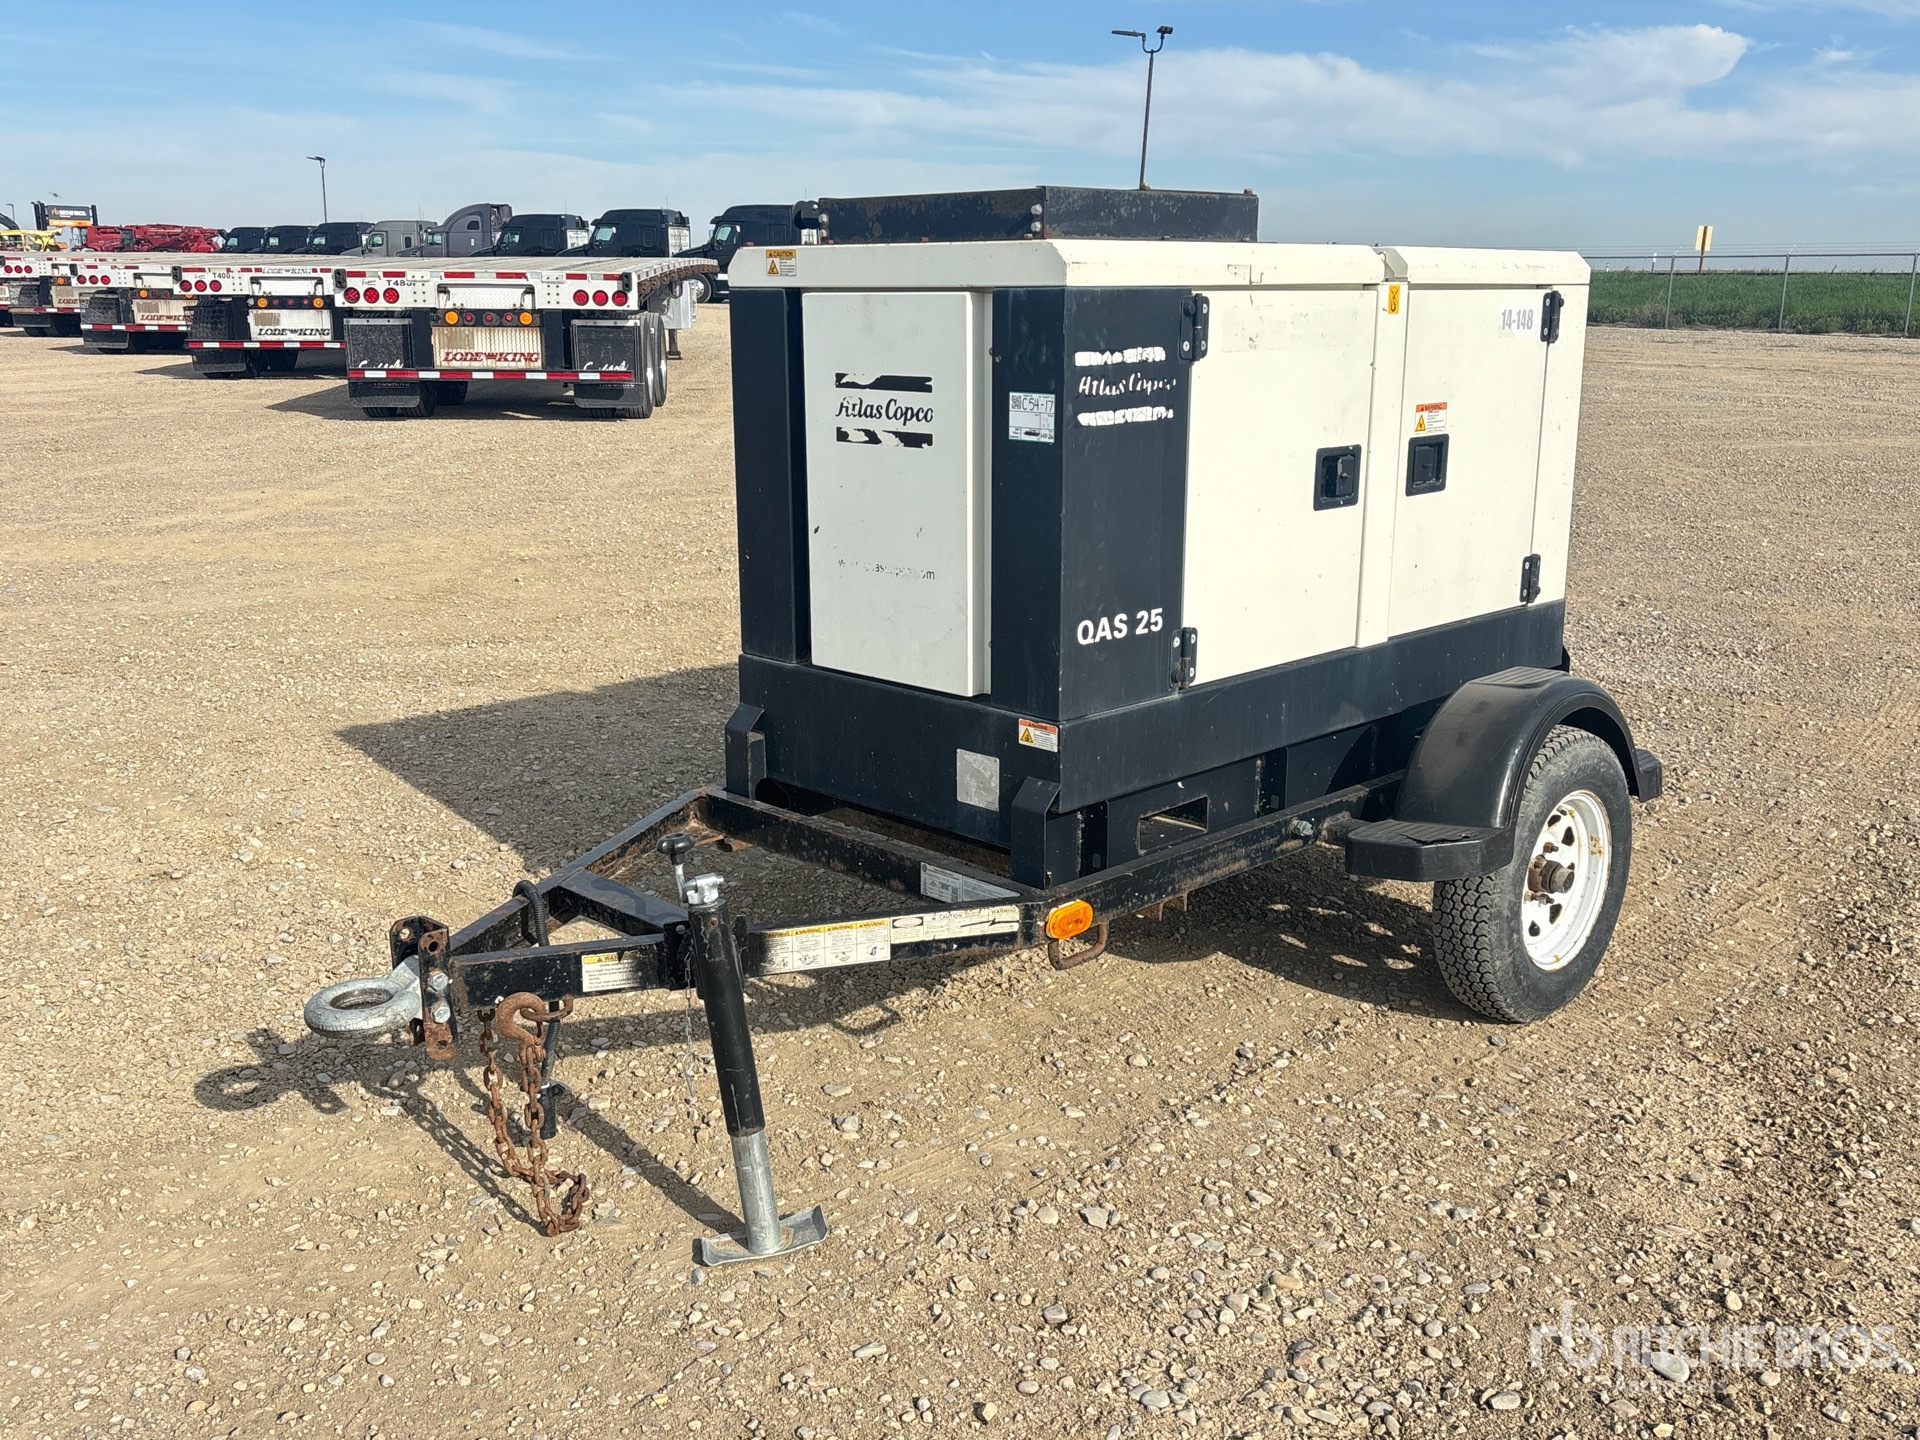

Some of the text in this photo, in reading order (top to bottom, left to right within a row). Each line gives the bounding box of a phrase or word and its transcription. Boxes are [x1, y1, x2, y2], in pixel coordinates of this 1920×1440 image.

[1501, 309, 1534, 330] 14-148
[258, 328, 330, 336] LODE KING
[442, 352, 541, 363] LODE KING
[835, 396, 934, 426] Atlas Copco
[1077, 607, 1163, 645] QAS 25
